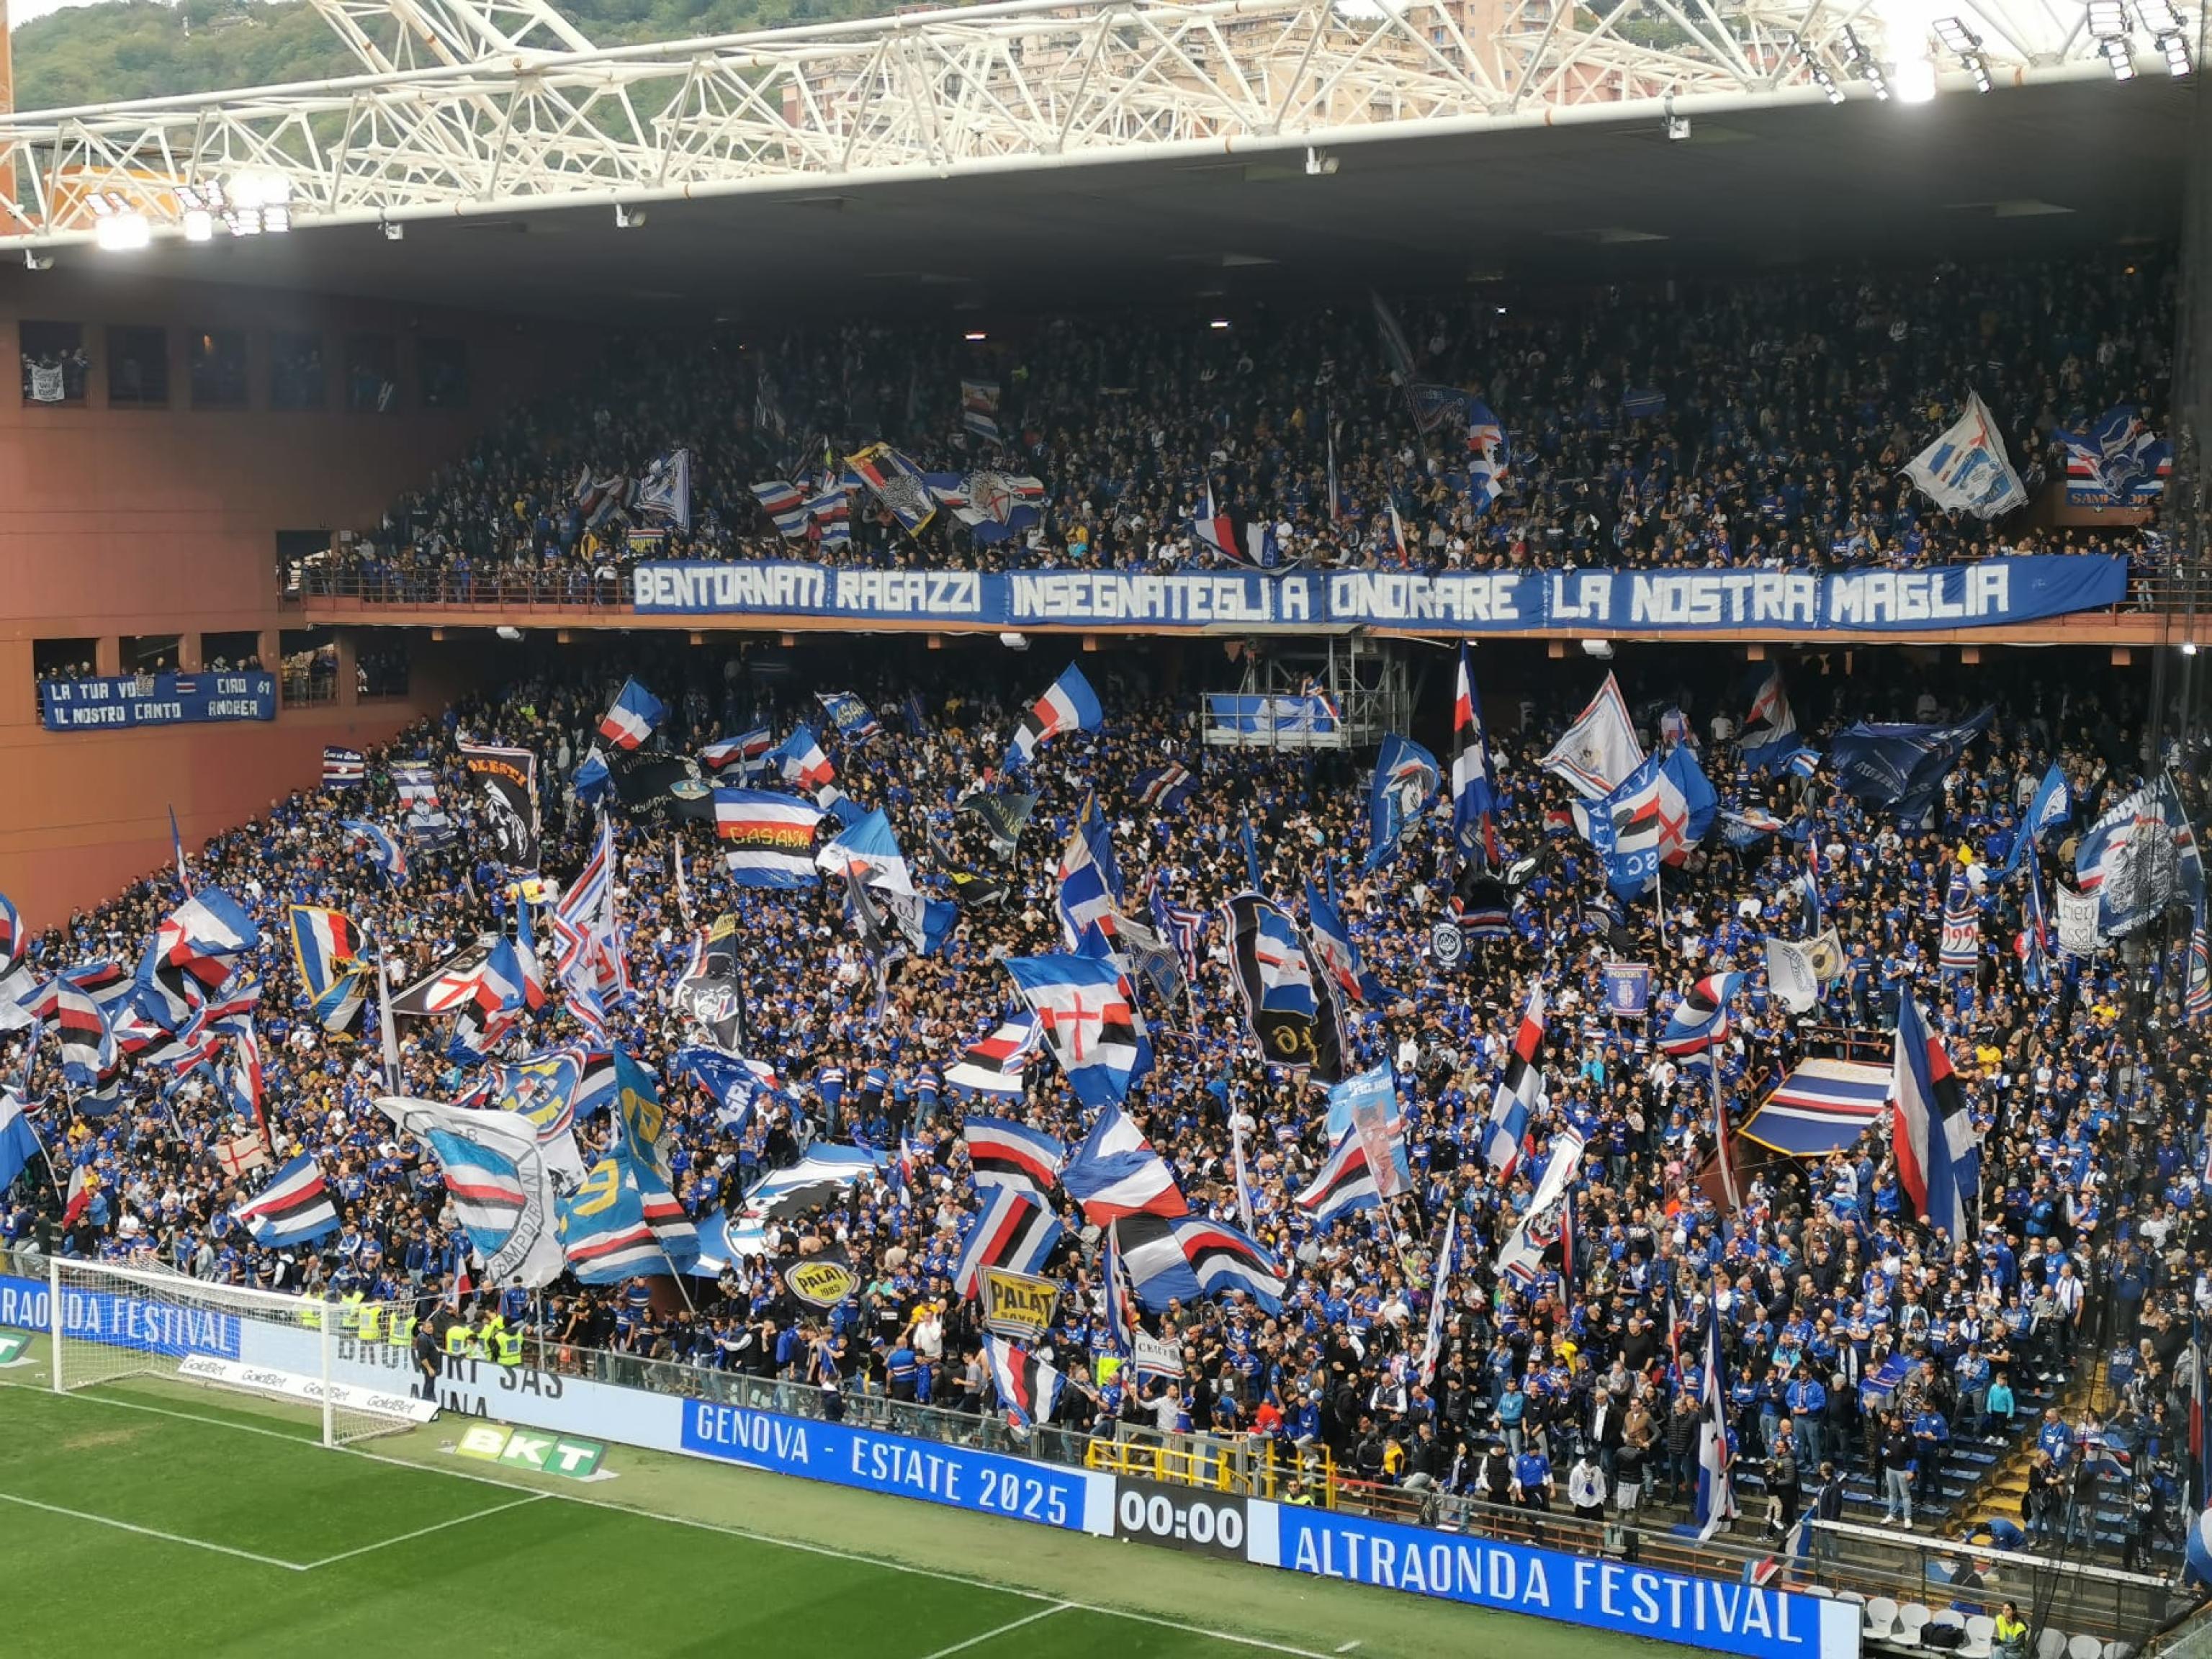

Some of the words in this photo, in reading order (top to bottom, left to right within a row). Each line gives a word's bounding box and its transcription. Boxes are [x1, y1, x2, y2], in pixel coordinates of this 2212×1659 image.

[634, 566, 824, 608] BENTORNATI
[836, 572, 980, 612] RAGAZZI
[1012, 574, 1272, 621] INSEGNATEGLI
[1282, 576, 1309, 620] A
[1331, 573, 1519, 621] ONORARE
[1552, 575, 1611, 620] LA
[1631, 573, 1815, 624] NOSTRA
[1830, 565, 2009, 623] MAGLIA
[51, 684, 71, 701] LA
[79, 683, 109, 699] TUA
[217, 678, 247, 694] CIAO
[55, 709, 68, 724] IL
[73, 706, 125, 723] NOSTRO
[135, 703, 181, 720] CANTO
[208, 701, 258, 716] ANDREA
[113, 1298, 232, 1352] FESTIVAL
[243, 1370, 287, 1388] GoldBet
[367, 1395, 415, 1413] GoldBet
[462, 1429, 594, 1473] BKT
[697, 1405, 809, 1464] GENOVA
[852, 1437, 963, 1501] ESTATE
[979, 1469, 1068, 1525] 2025
[1120, 1491, 1244, 1549] 00:00
[1295, 1527, 1550, 1607] ALTRAONDA
[1574, 1562, 1803, 1642] FESTIVAL
